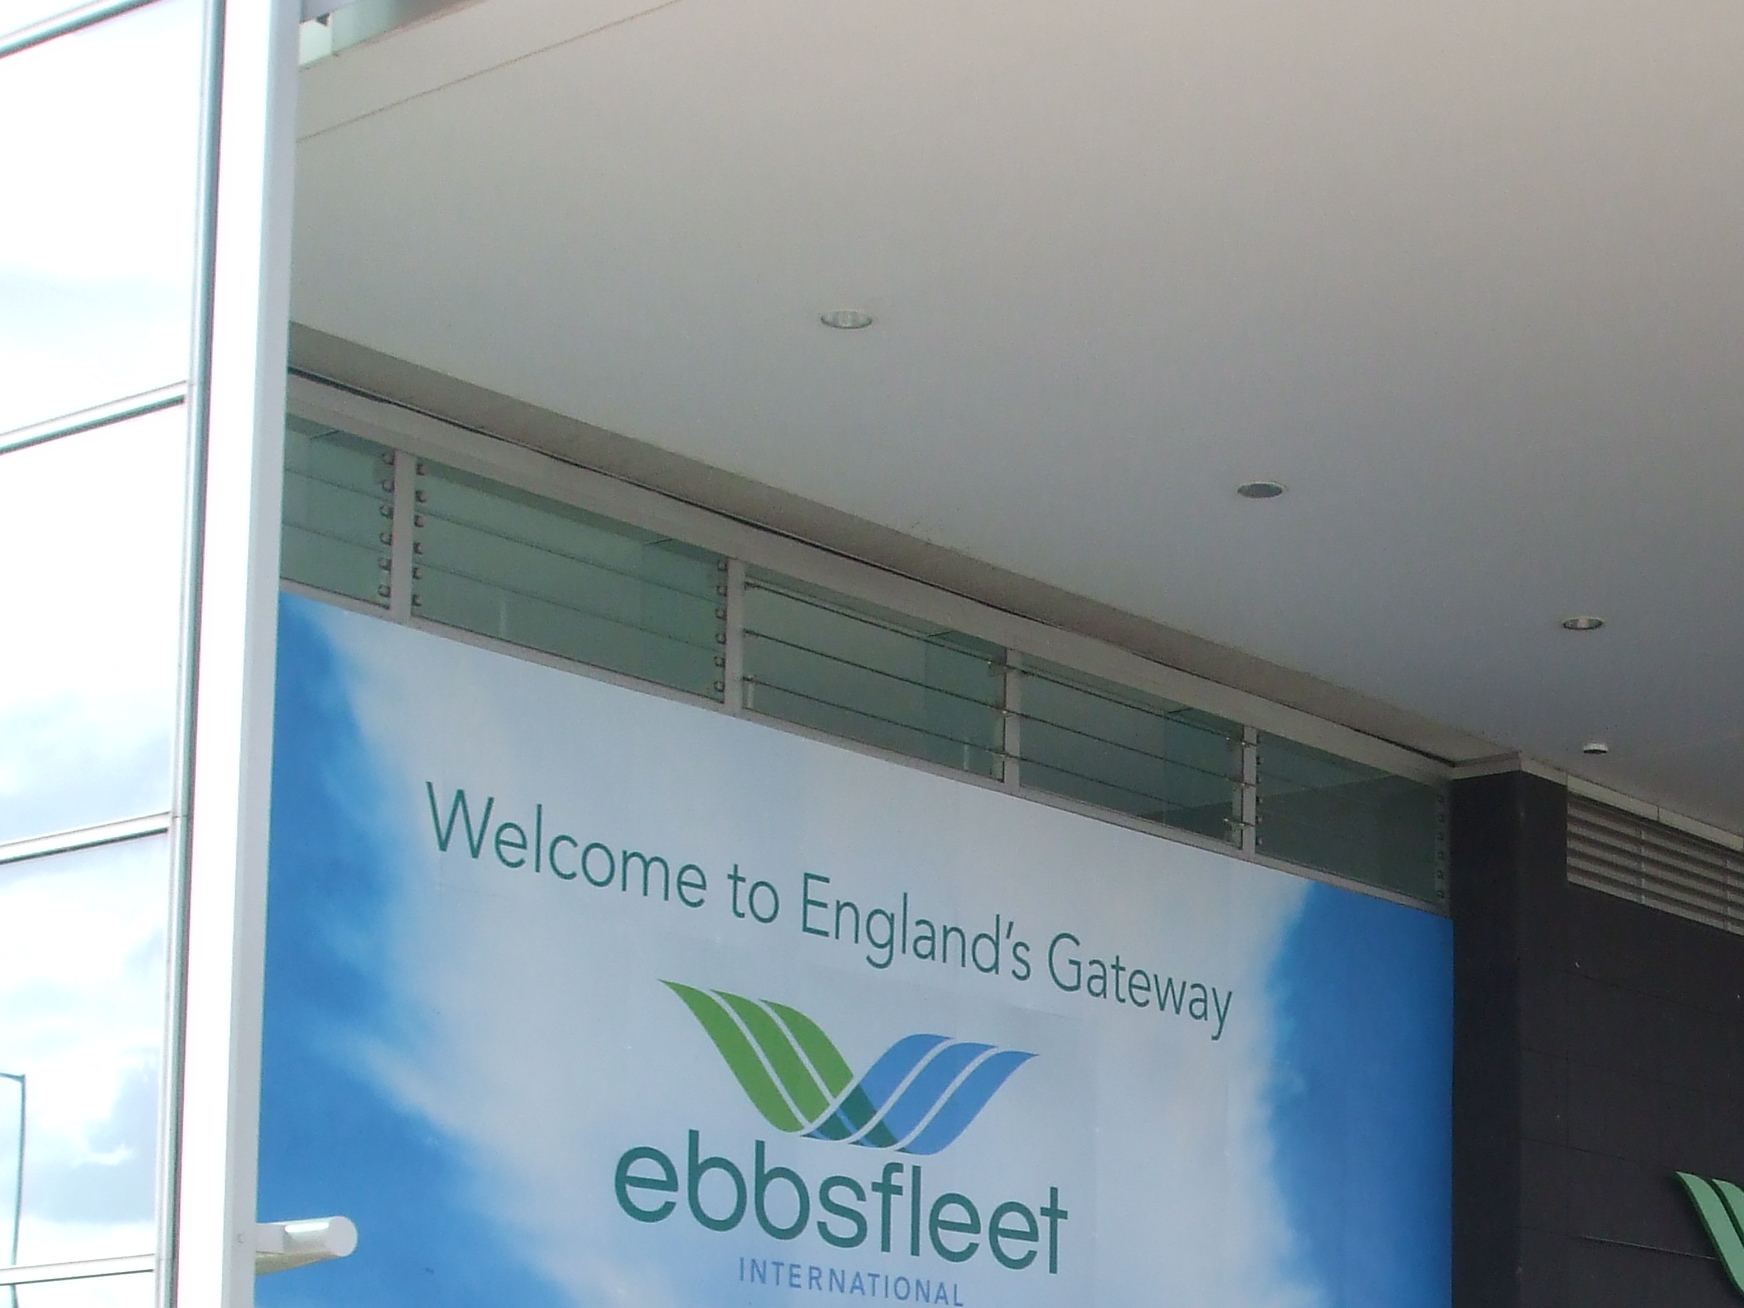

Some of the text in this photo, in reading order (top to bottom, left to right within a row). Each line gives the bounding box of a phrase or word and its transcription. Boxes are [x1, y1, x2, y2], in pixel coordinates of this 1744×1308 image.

[426, 781, 1233, 1041] Welcome to England's Gateway
[614, 1130, 1069, 1274] ebbsfleet
[740, 1256, 964, 1308] INTERNATIONAL
